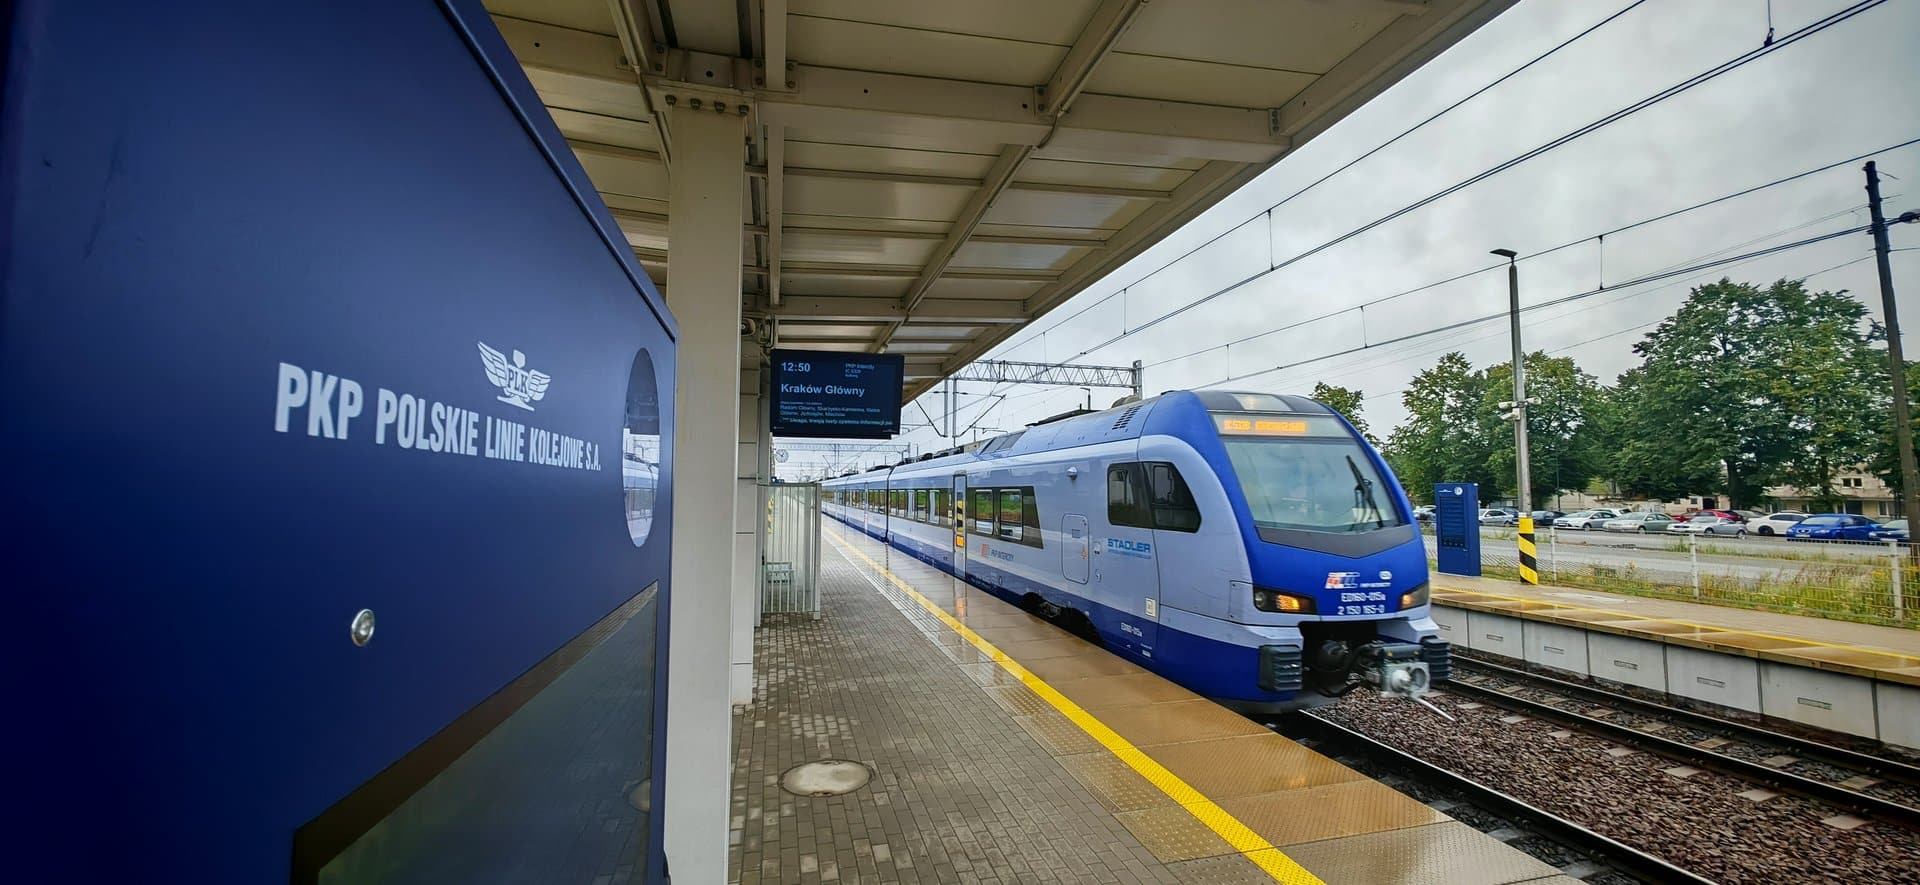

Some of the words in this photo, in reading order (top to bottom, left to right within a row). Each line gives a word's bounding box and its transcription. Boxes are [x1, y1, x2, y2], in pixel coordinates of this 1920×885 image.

[781, 361, 811, 372] 12:50
[507, 366, 528, 393] PLK
[781, 383, 822, 394] Kraków
[825, 385, 865, 397] Główny
[275, 362, 363, 440] PKP
[375, 388, 479, 456] POLSKIE
[485, 416, 525, 462] LINIE
[529, 427, 584, 470] KOLEJOWE
[585, 442, 601, 471] S.A.
[1108, 538, 1151, 553] STADLER
[1337, 606, 1345, 615] 2
[1346, 605, 1361, 615] 150
